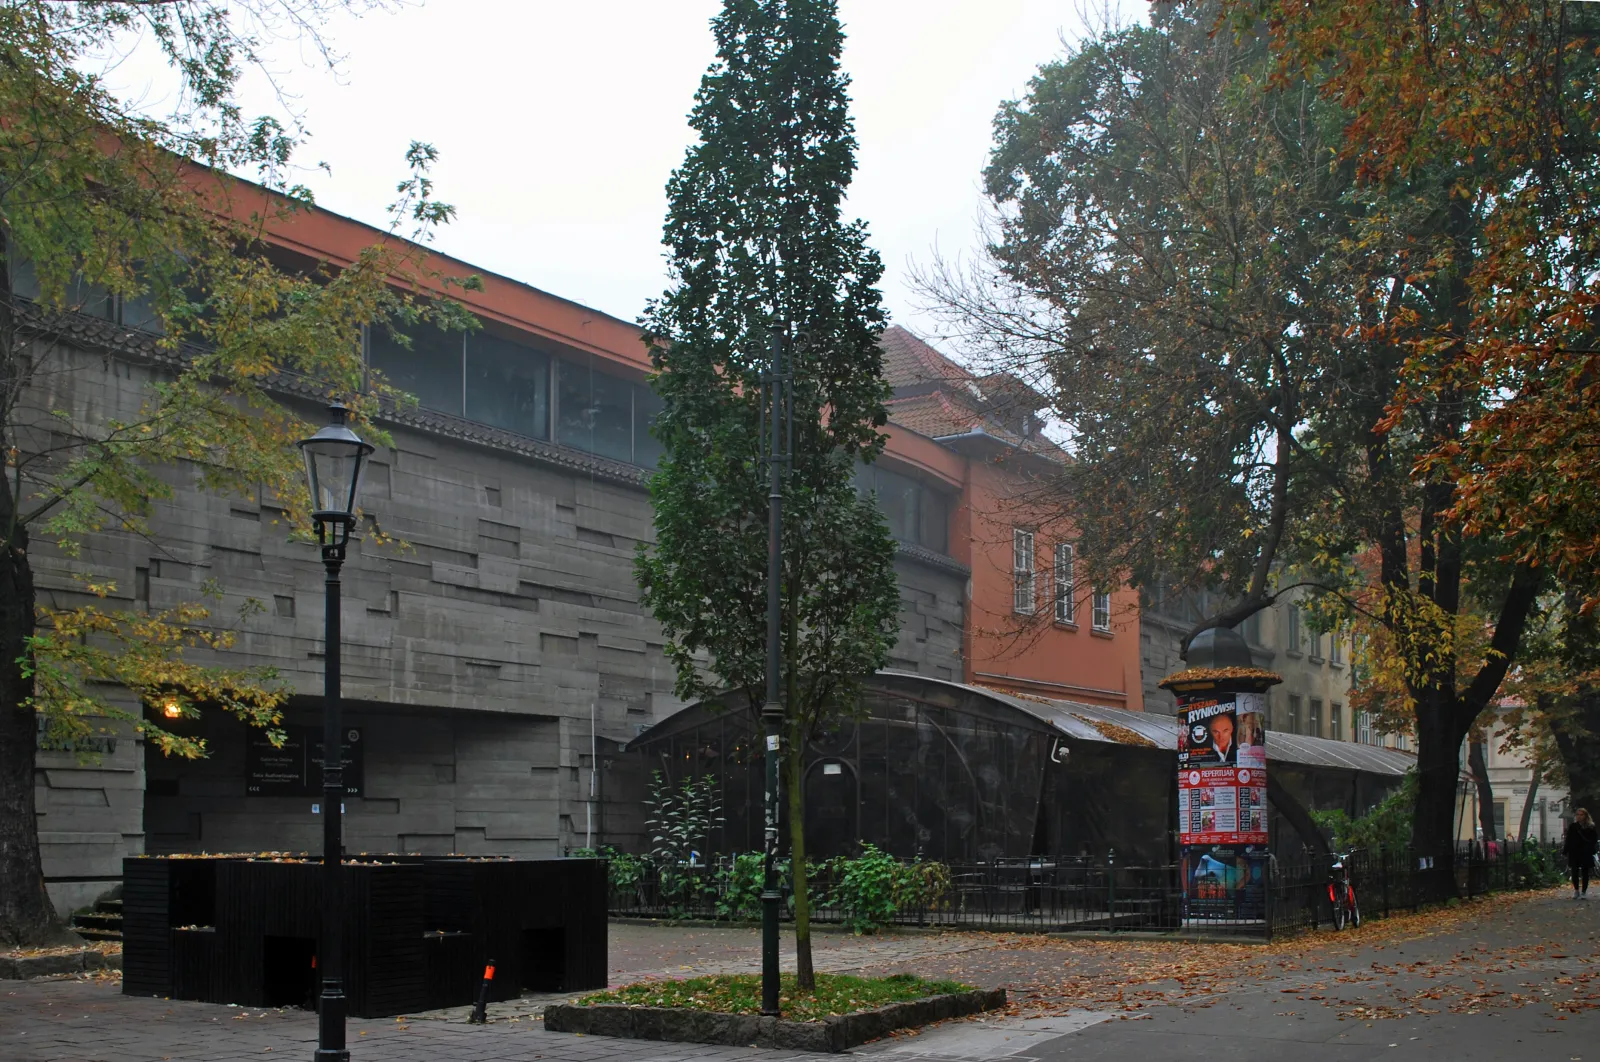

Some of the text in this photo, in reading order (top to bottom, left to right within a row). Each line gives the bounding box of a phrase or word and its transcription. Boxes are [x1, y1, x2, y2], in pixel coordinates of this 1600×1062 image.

[1189, 699, 1218, 711] RYSZARD
[1188, 702, 1236, 723] RYNKOWSKI
[1201, 769, 1235, 778] REPERTUAR
